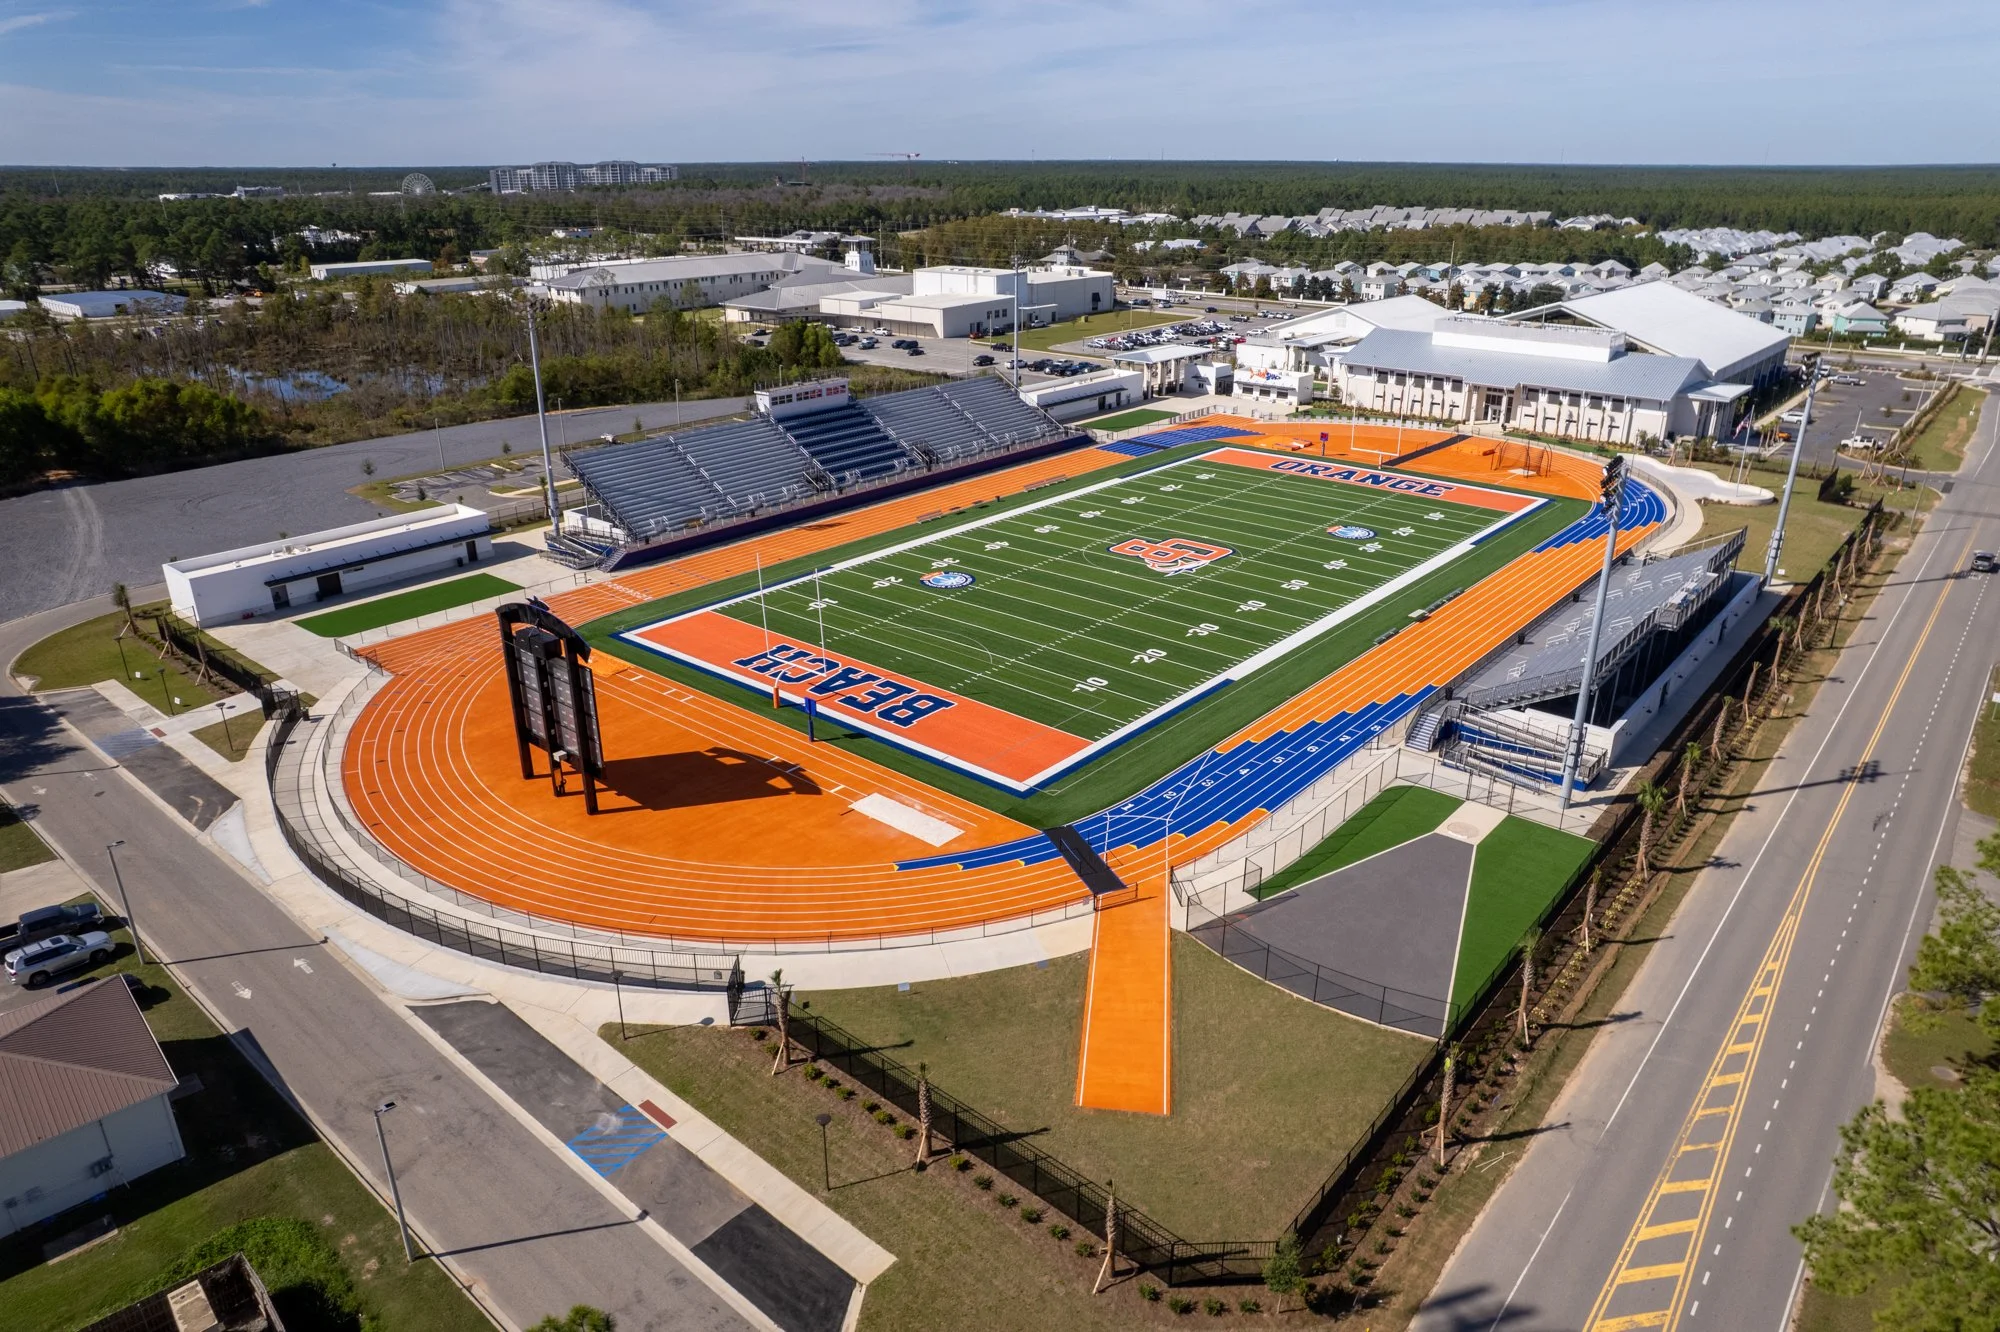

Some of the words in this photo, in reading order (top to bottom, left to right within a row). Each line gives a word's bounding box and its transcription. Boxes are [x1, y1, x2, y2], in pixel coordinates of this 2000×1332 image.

[1269, 460, 1456, 497] ORANGE
[873, 576, 903, 588] 20
[932, 557, 960, 568] 30
[1076, 677, 1109, 692] 10
[1133, 648, 1168, 664] 20
[1188, 623, 1220, 636] 30
[1239, 600, 1267, 611] 40
[1281, 579, 1310, 591] 50
[731, 643, 958, 728] BEACH
[1120, 803, 1135, 811] 1
[1163, 791, 1177, 799] 2
[1239, 768, 1250, 776] 4
[1272, 756, 1285, 764] 5
[1307, 745, 1319, 753] 6
[1339, 734, 1351, 742] 7
